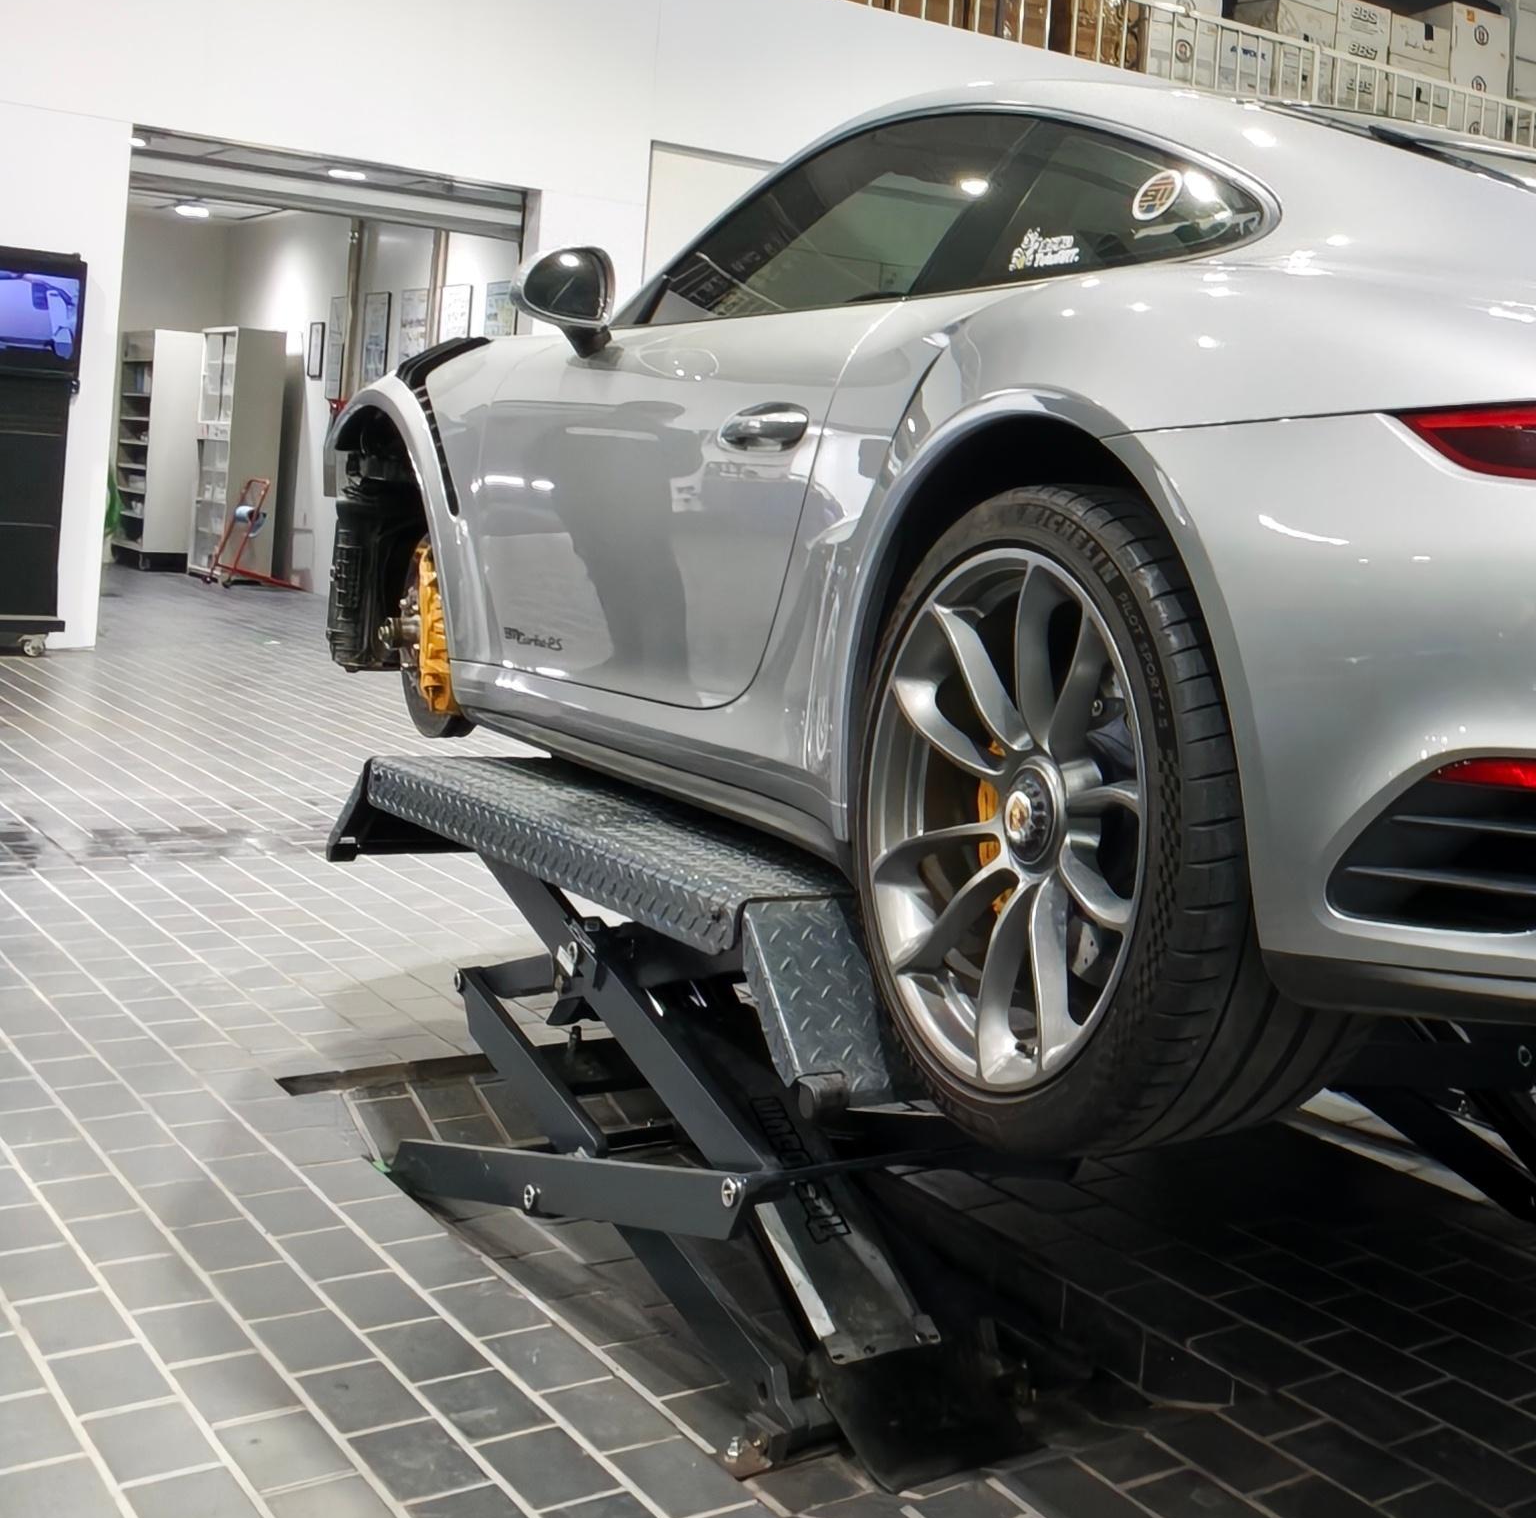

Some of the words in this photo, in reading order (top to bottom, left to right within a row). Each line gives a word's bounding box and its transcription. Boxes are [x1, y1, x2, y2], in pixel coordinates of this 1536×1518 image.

[1351, 5, 1378, 25] BBS
[1348, 42, 1378, 61] BBS
[1118, 592, 1144, 634] PILOT
[1139, 641, 1164, 701] SPORT
